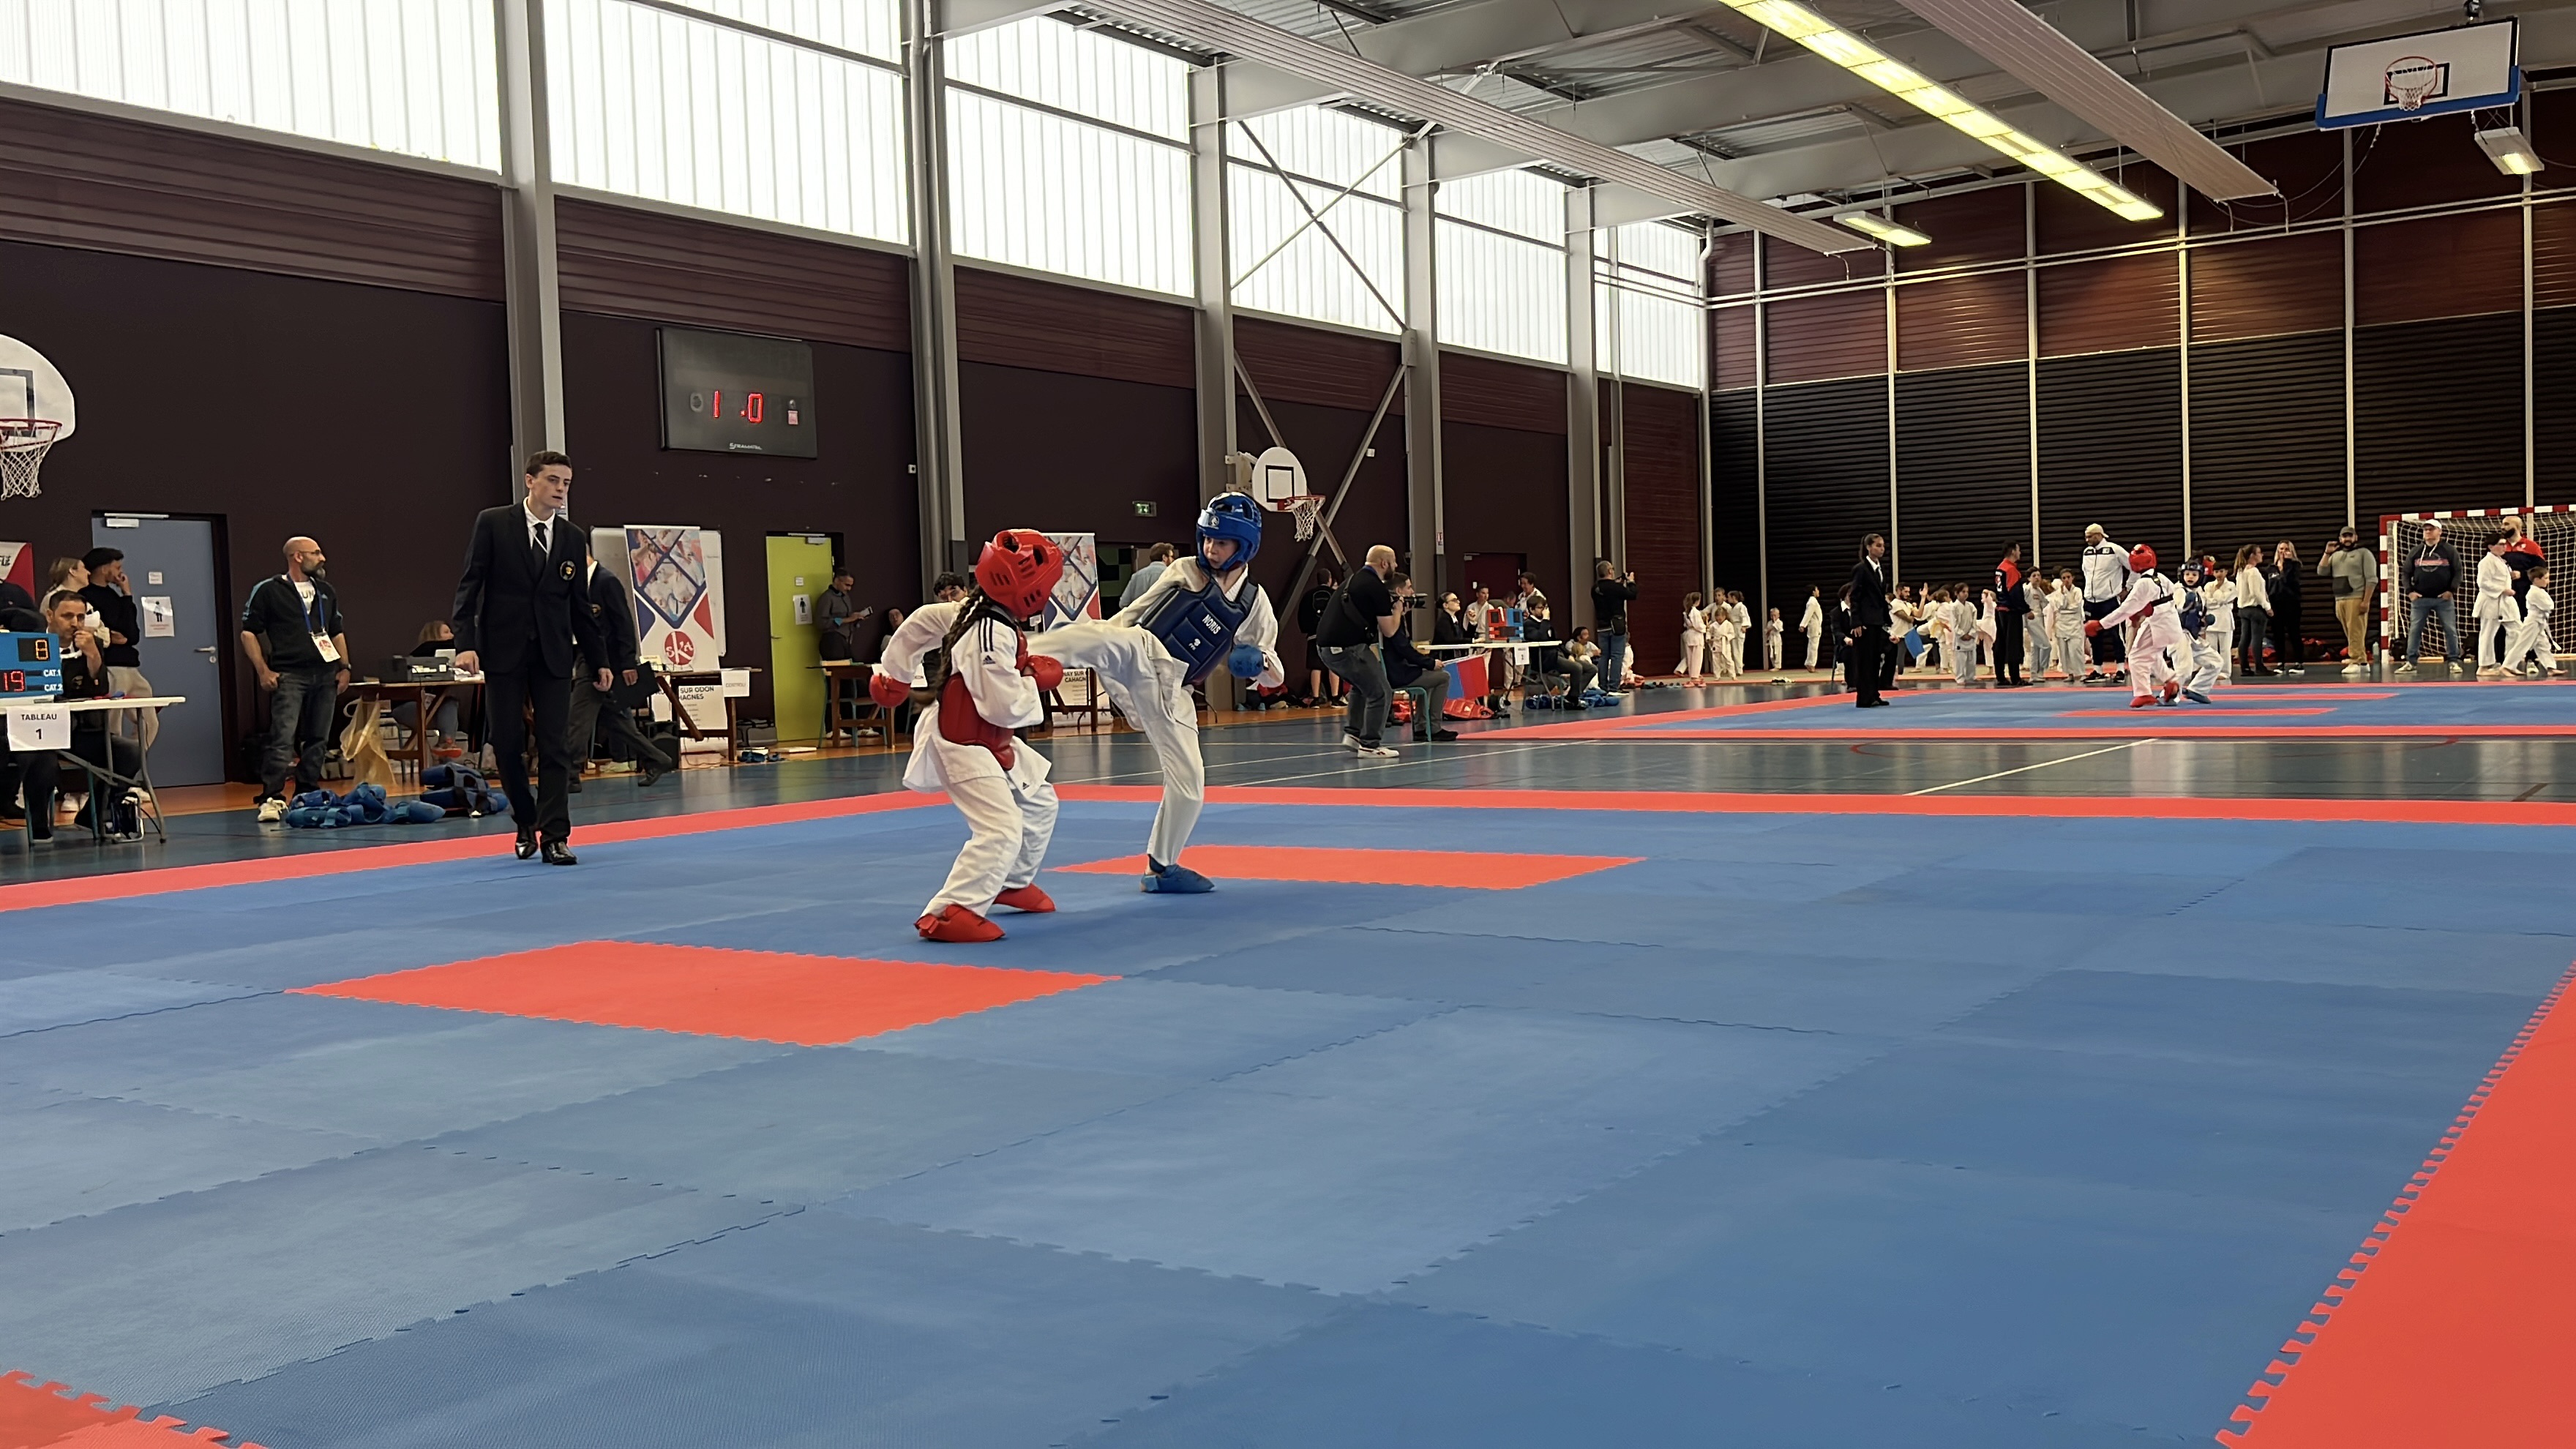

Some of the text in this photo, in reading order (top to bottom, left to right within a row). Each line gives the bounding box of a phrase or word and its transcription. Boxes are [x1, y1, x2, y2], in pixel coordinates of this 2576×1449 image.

[1202, 614, 1221, 634] NORIS
[35, 639, 48, 660] 8
[4, 670, 25, 692] 19
[44, 684, 63, 692] CAT.2
[35, 728, 42, 740] 1
